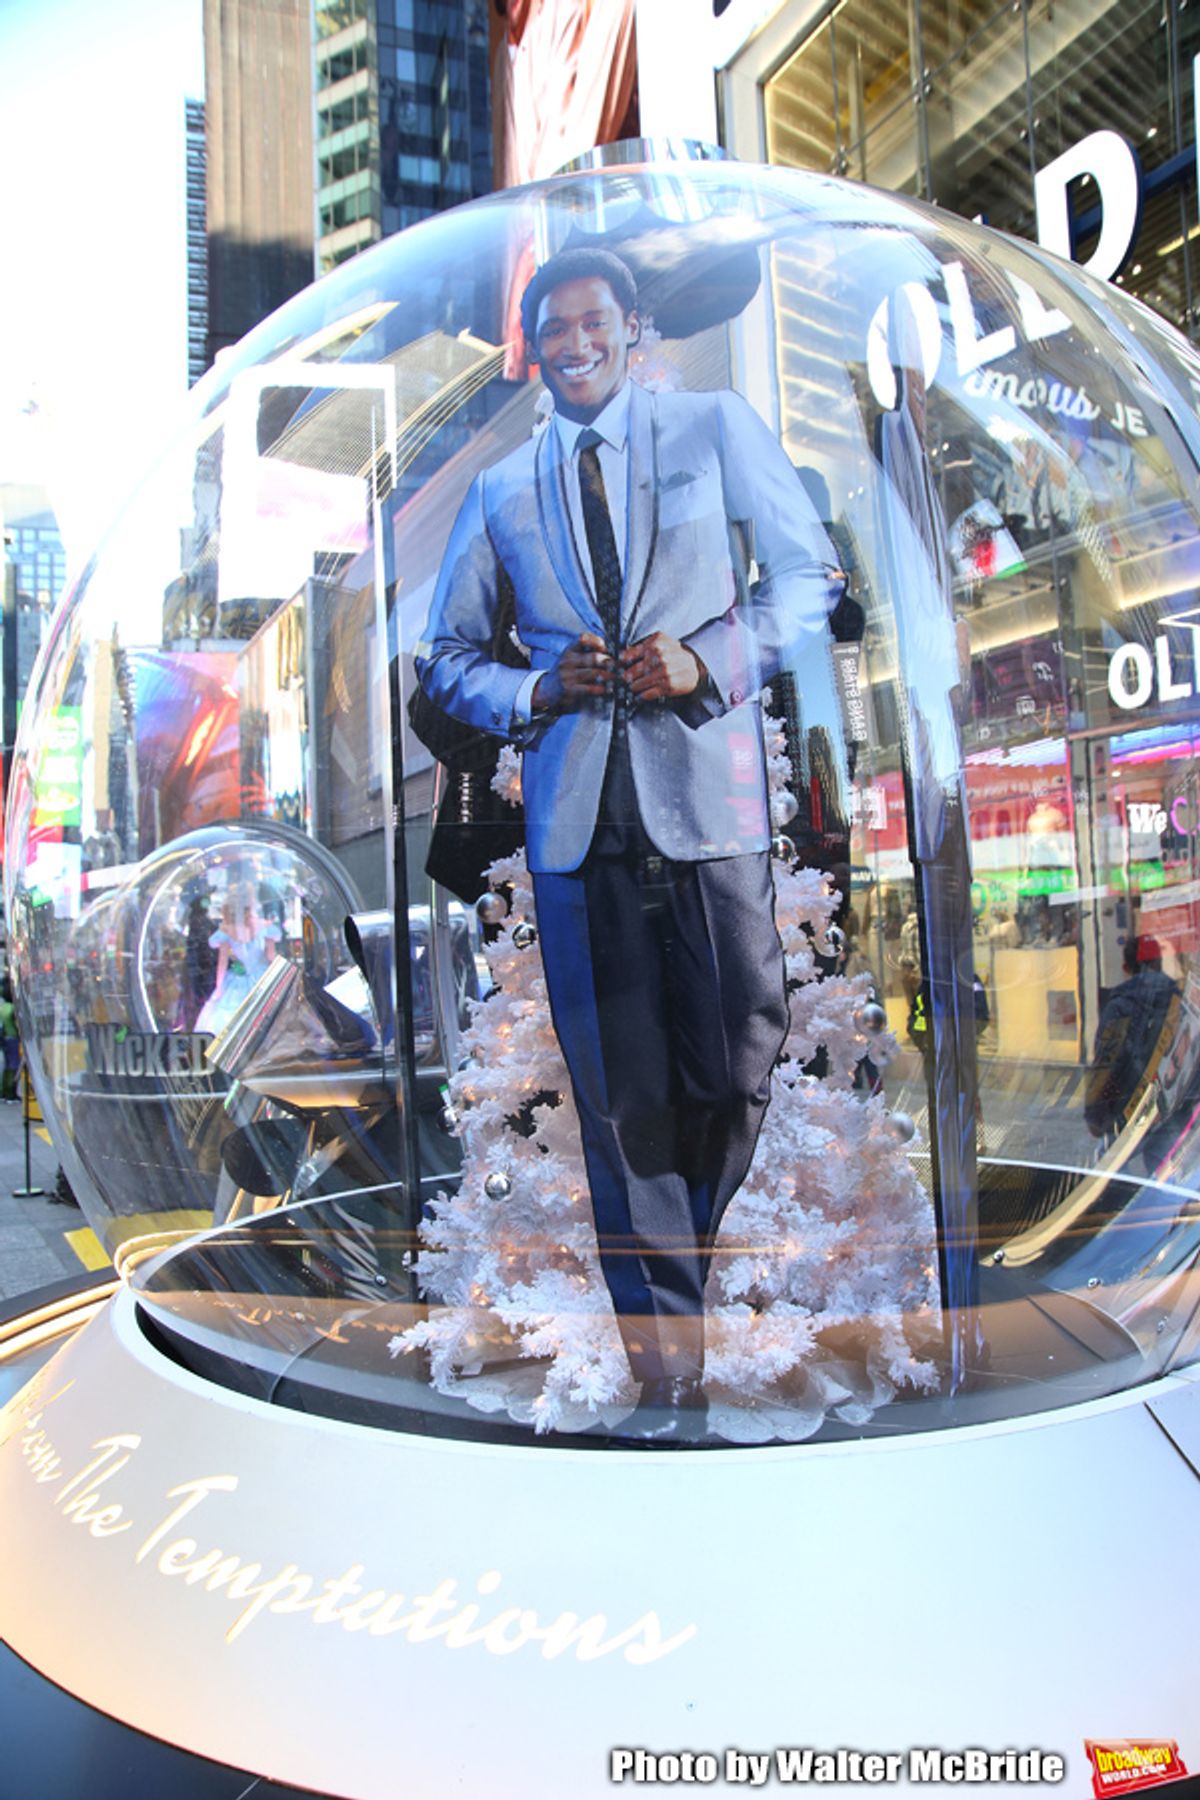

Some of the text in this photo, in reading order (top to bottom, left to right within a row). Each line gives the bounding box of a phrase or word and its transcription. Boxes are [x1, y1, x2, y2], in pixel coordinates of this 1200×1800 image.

[1109, 627, 1200, 710] OL
[55, 1433, 142, 1537] The
[135, 1473, 698, 1665] Temptations
